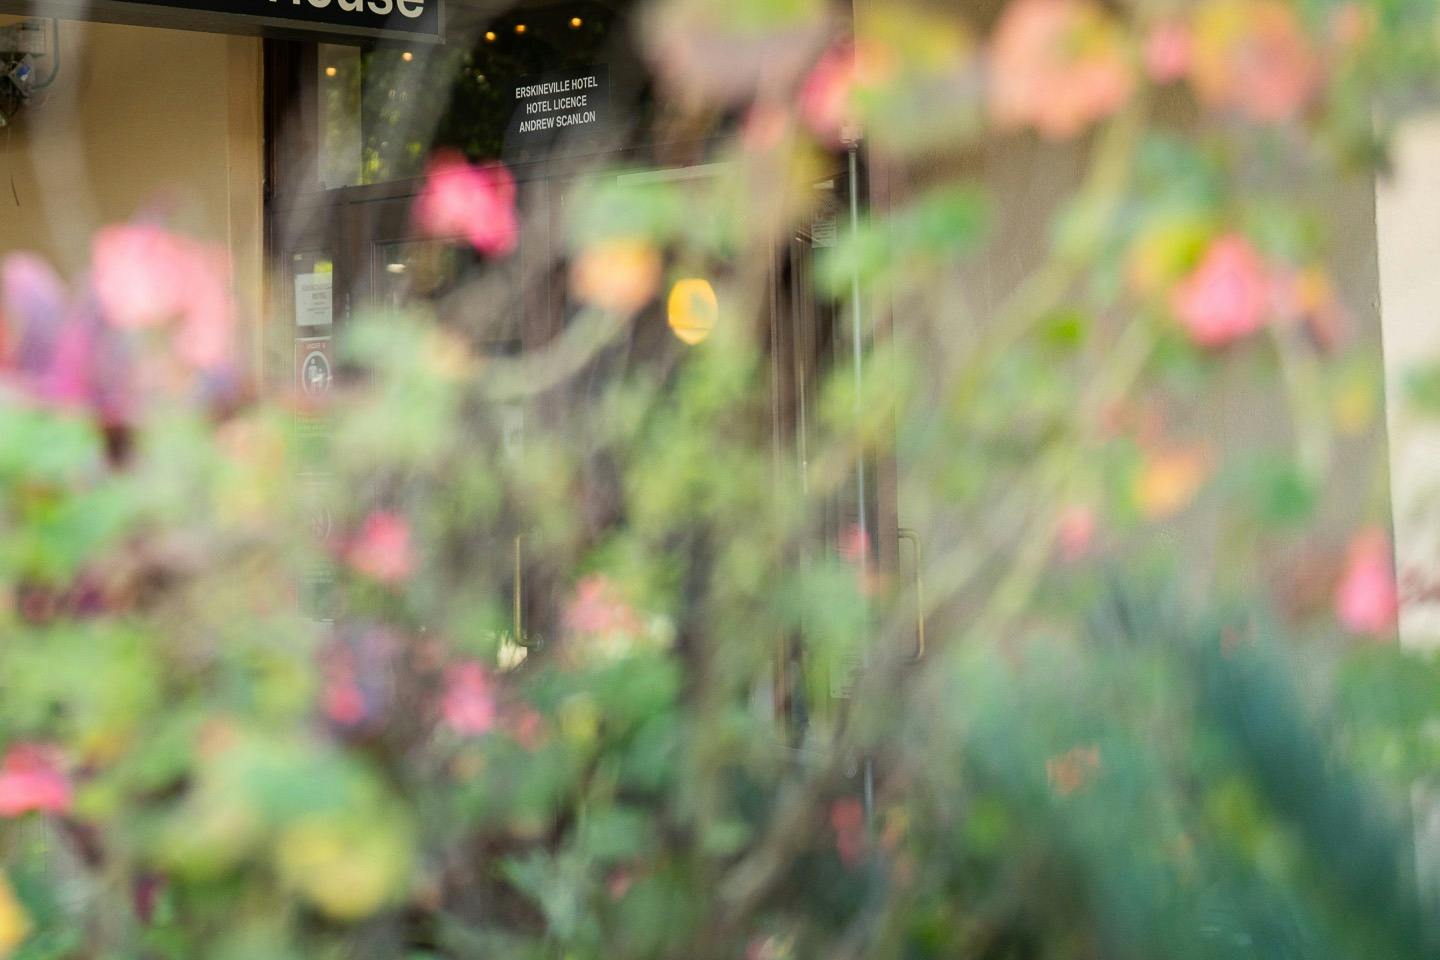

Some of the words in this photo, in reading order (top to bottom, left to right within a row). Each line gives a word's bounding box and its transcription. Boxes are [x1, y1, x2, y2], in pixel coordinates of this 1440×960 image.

[515, 79, 570, 99] ERSKINEVILLE
[571, 76, 598, 91] HOTEL
[526, 100, 553, 115] HOTEL
[553, 95, 587, 111] LICENCE
[519, 117, 555, 133] ANDREW
[556, 111, 596, 128] SCANLON
